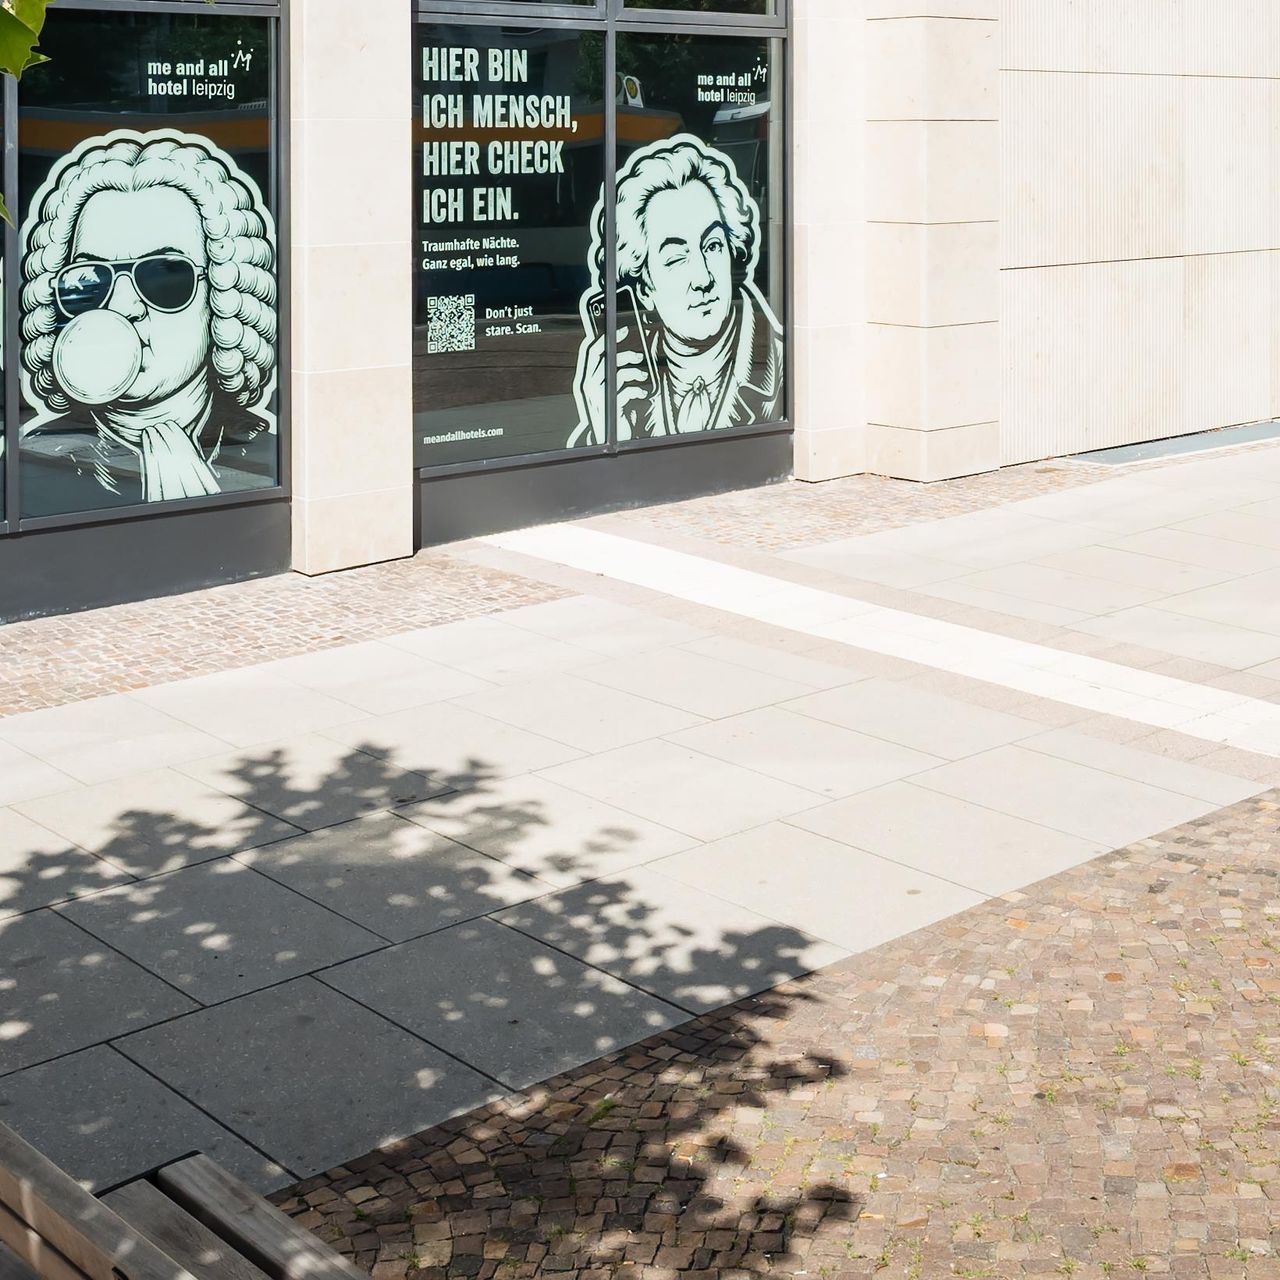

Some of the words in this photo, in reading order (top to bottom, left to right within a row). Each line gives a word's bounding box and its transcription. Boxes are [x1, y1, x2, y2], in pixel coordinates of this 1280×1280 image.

[147, 61, 171, 75] me
[175, 59, 204, 76] and
[208, 59, 227, 77] all
[422, 46, 480, 82] HIER
[487, 48, 528, 83] BIN
[147, 77, 187, 96] hotel
[192, 78, 236, 100] leipzig
[697, 74, 713, 86] me
[716, 72, 735, 87] and
[737, 72, 751, 87] all
[697, 87, 723, 102] hotel
[726, 88, 755, 106] leipzig
[422, 93, 464, 129] ICH
[472, 94, 579, 134] MENSCH,
[423, 140, 480, 176] HIER
[487, 140, 565, 175] CHECK
[423, 188, 464, 224] ICH
[472, 186, 520, 222] EIN.
[421, 238, 480, 253] Traumhafte
[482, 236, 519, 251] Nächte.
[422, 258, 447, 270] Ganz
[449, 256, 474, 271] egal,
[476, 254, 493, 267] wie
[496, 254, 520, 269] lang.
[485, 305, 512, 320] Don’t
[513, 304, 533, 319] just
[485, 324, 513, 338] stare.
[515, 322, 541, 335] Scan.
[423, 426, 504, 445] meandallhotels.com
